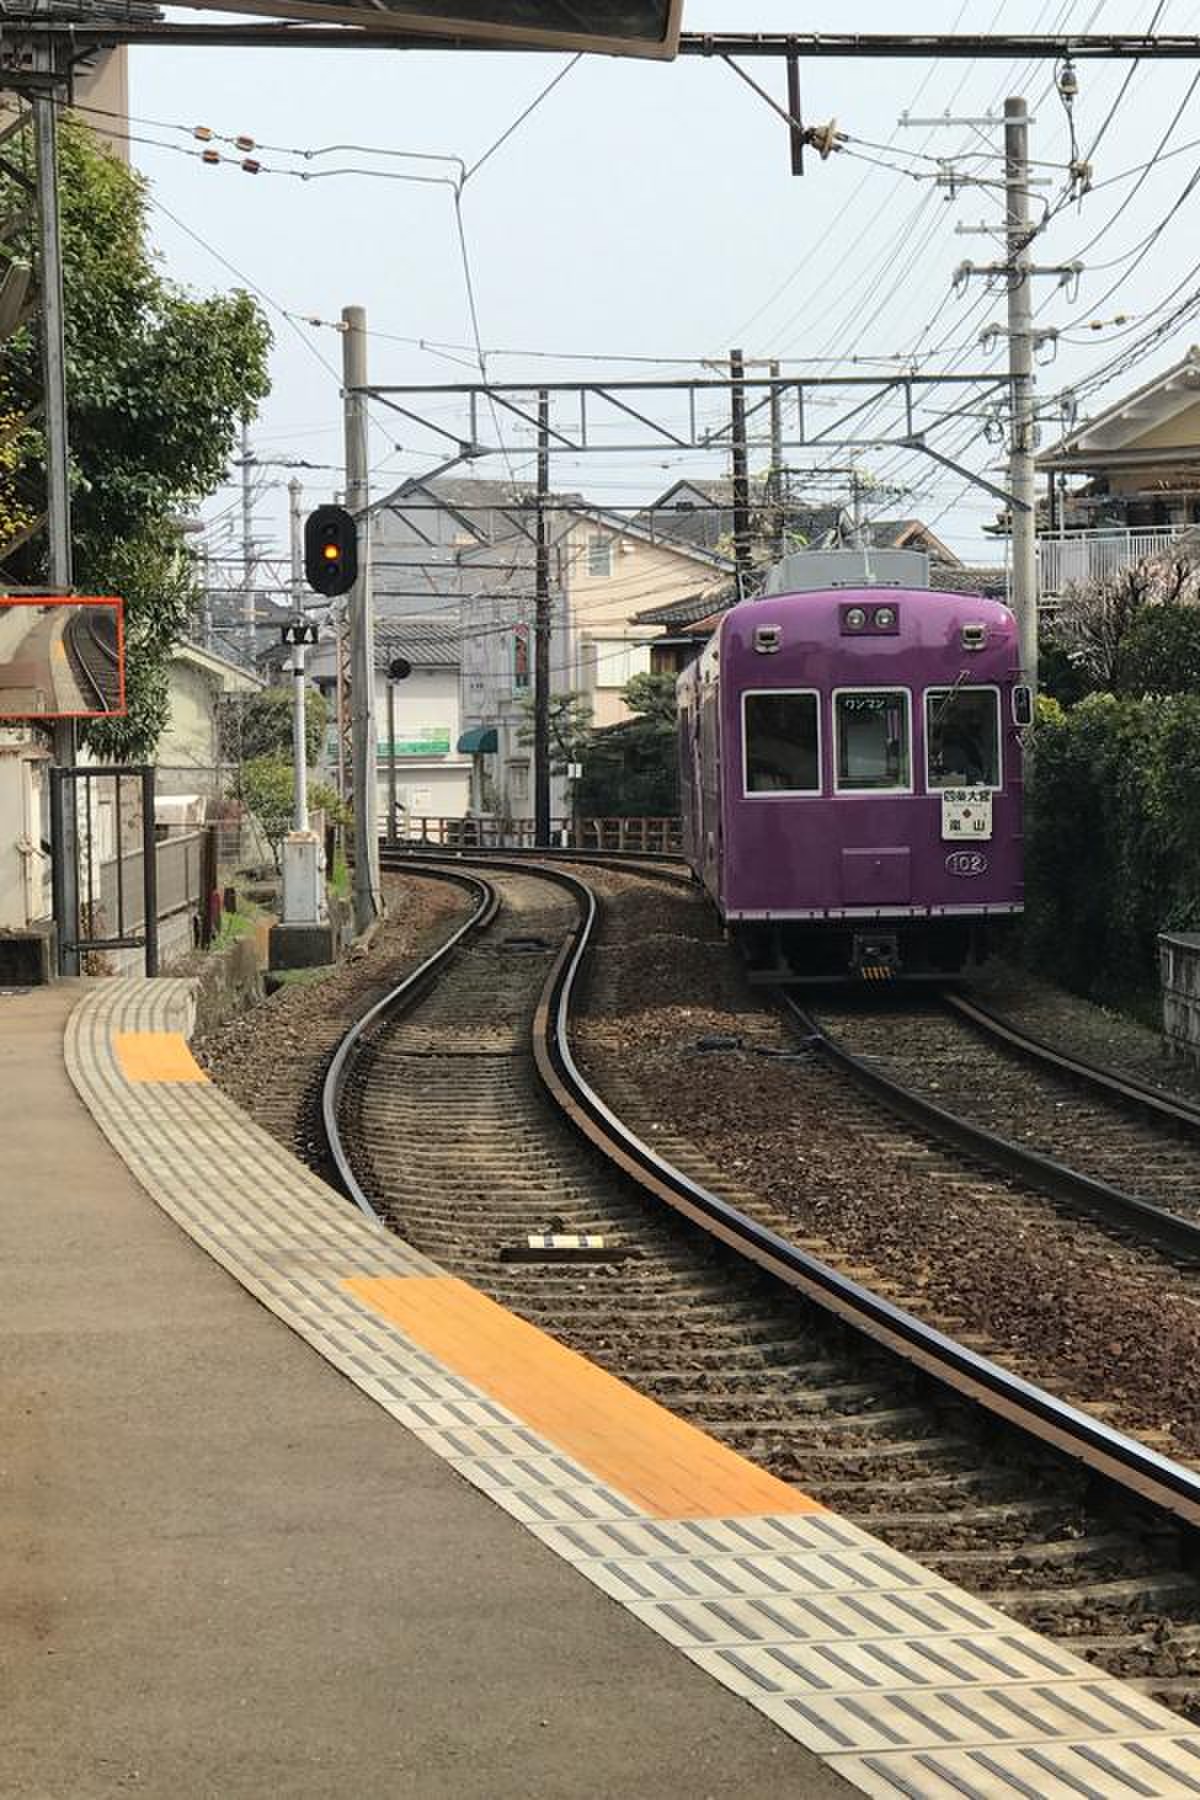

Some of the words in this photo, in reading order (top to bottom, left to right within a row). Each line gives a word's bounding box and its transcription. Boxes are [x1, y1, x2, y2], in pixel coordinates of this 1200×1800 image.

[846, 699, 885, 710] ワンマン
[952, 855, 982, 871] 102
